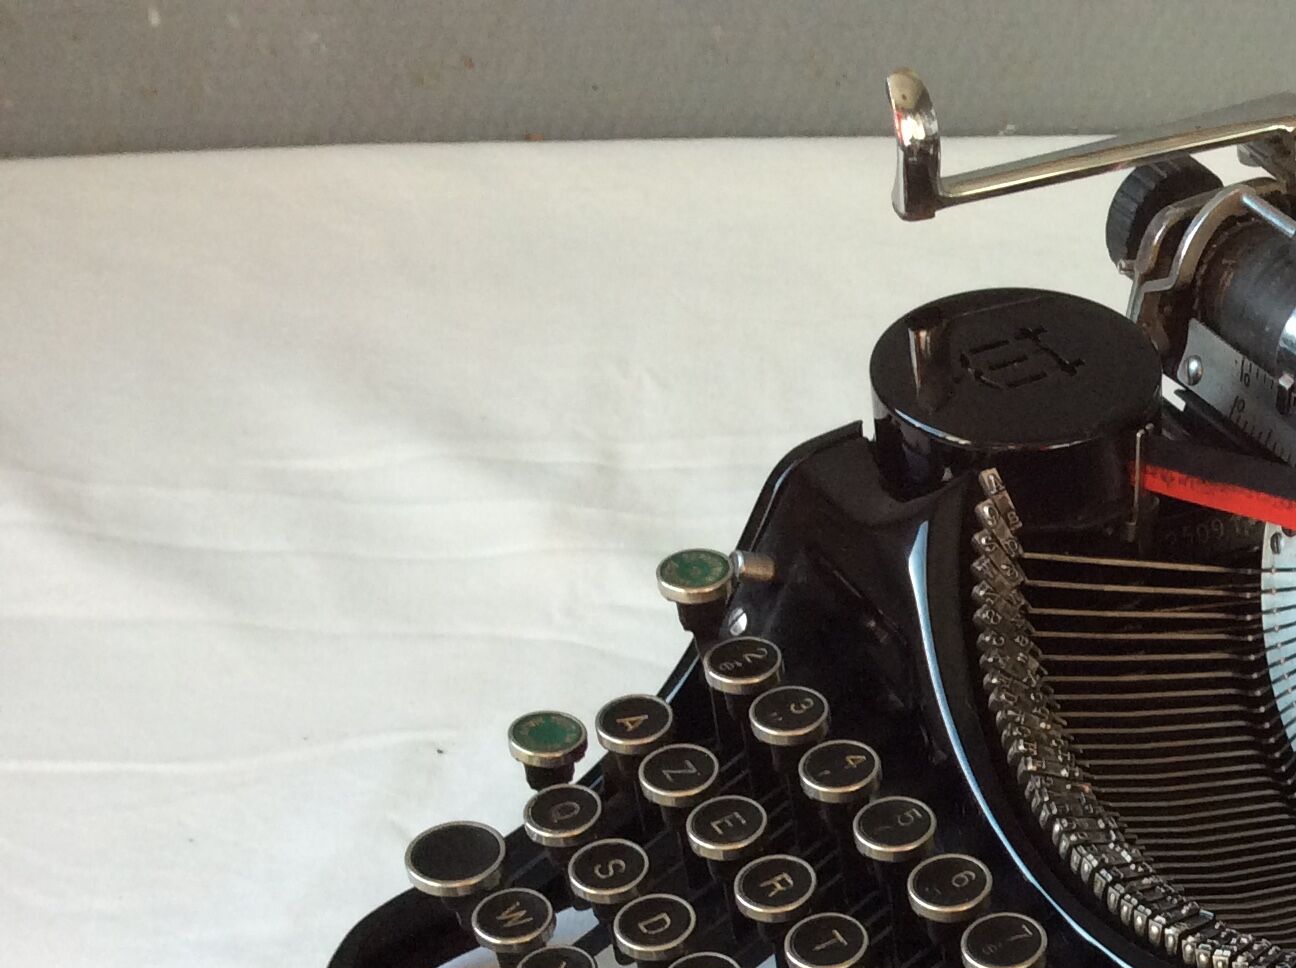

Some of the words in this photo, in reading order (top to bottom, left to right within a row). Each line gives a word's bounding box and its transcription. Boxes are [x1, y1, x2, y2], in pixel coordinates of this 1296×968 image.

[742, 647, 768, 663] 2
[789, 697, 815, 714] 3
[616, 714, 649, 732] A
[661, 759, 697, 782] Z
[845, 755, 867, 768] 4
[551, 801, 581, 824] Q
[710, 811, 747, 835] E
[897, 807, 923, 826] 5
[594, 858, 626, 879] S
[951, 870, 976, 888] 6
[760, 872, 794, 898] R
[496, 901, 534, 928] W
[637, 912, 672, 935] D
[814, 929, 848, 951] T
[1005, 921, 1035, 942] 7
